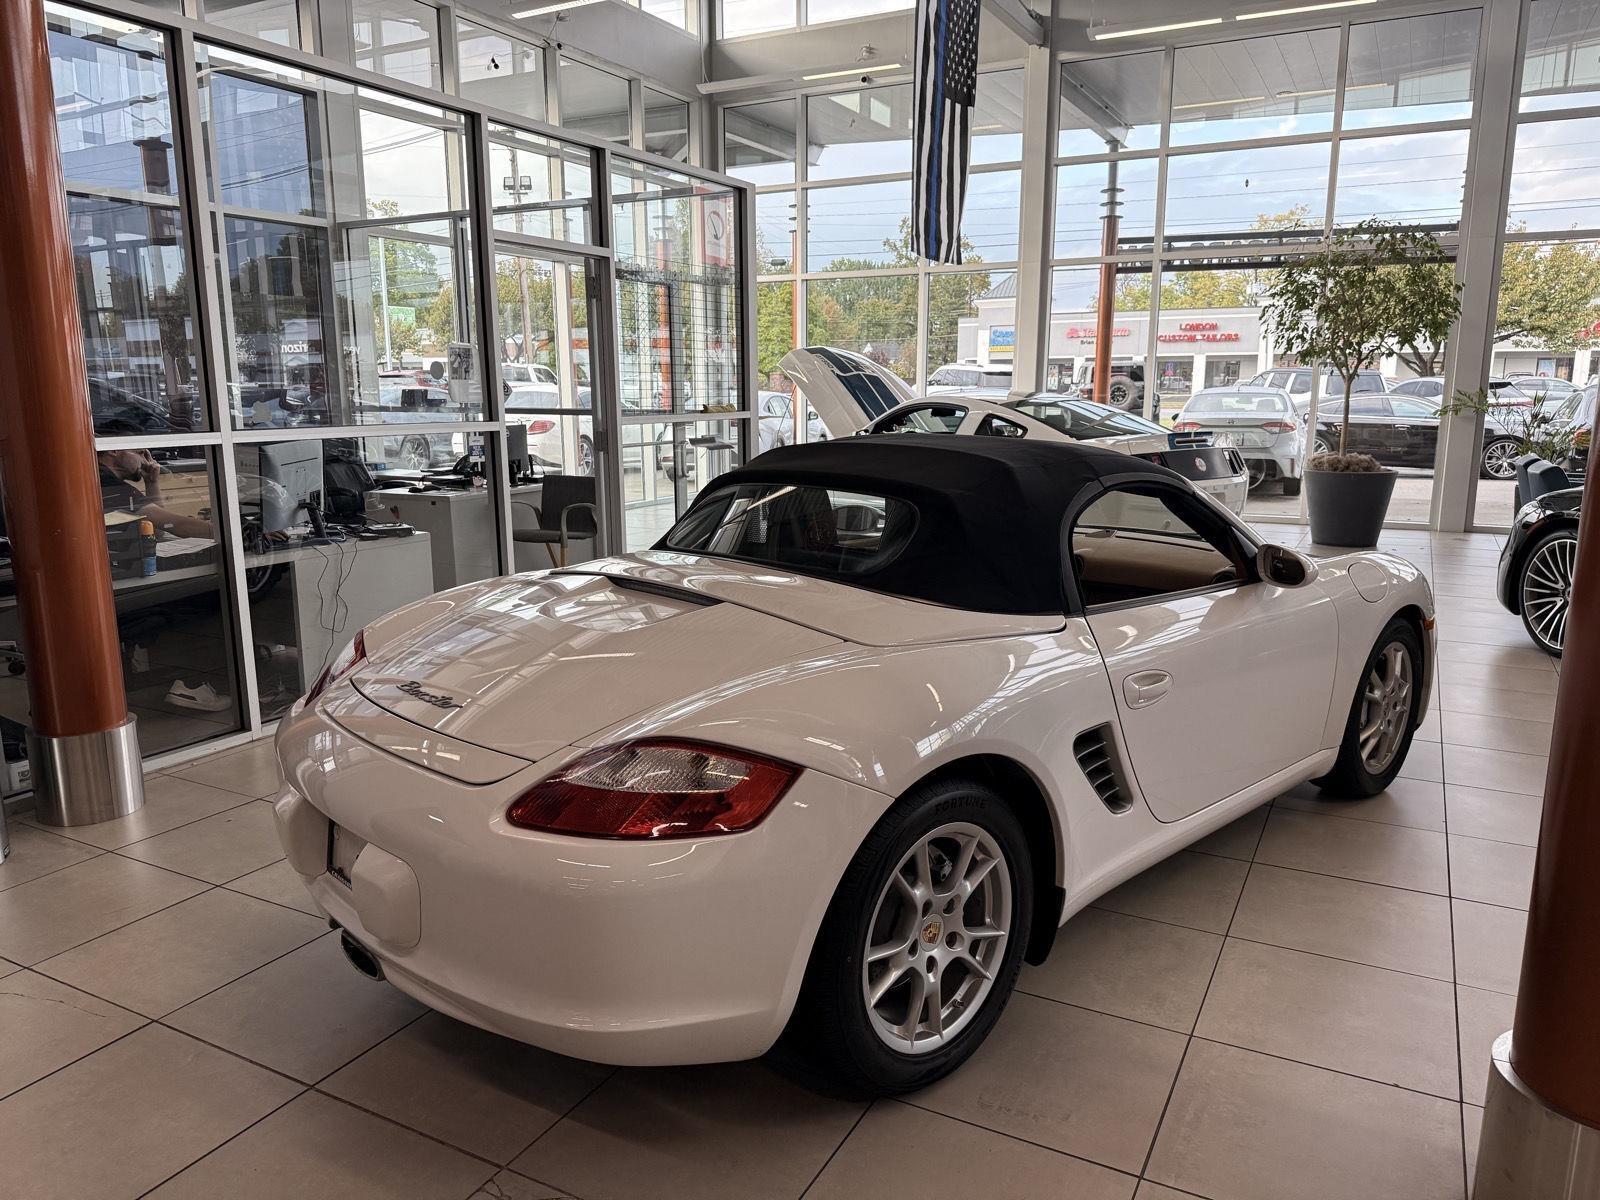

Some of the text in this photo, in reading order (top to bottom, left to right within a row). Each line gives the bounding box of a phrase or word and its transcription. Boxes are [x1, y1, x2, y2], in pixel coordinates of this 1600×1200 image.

[1180, 323, 1218, 331] LONDON
[396, 681, 463, 709] Boxster
[934, 796, 986, 815] FORTUNE
